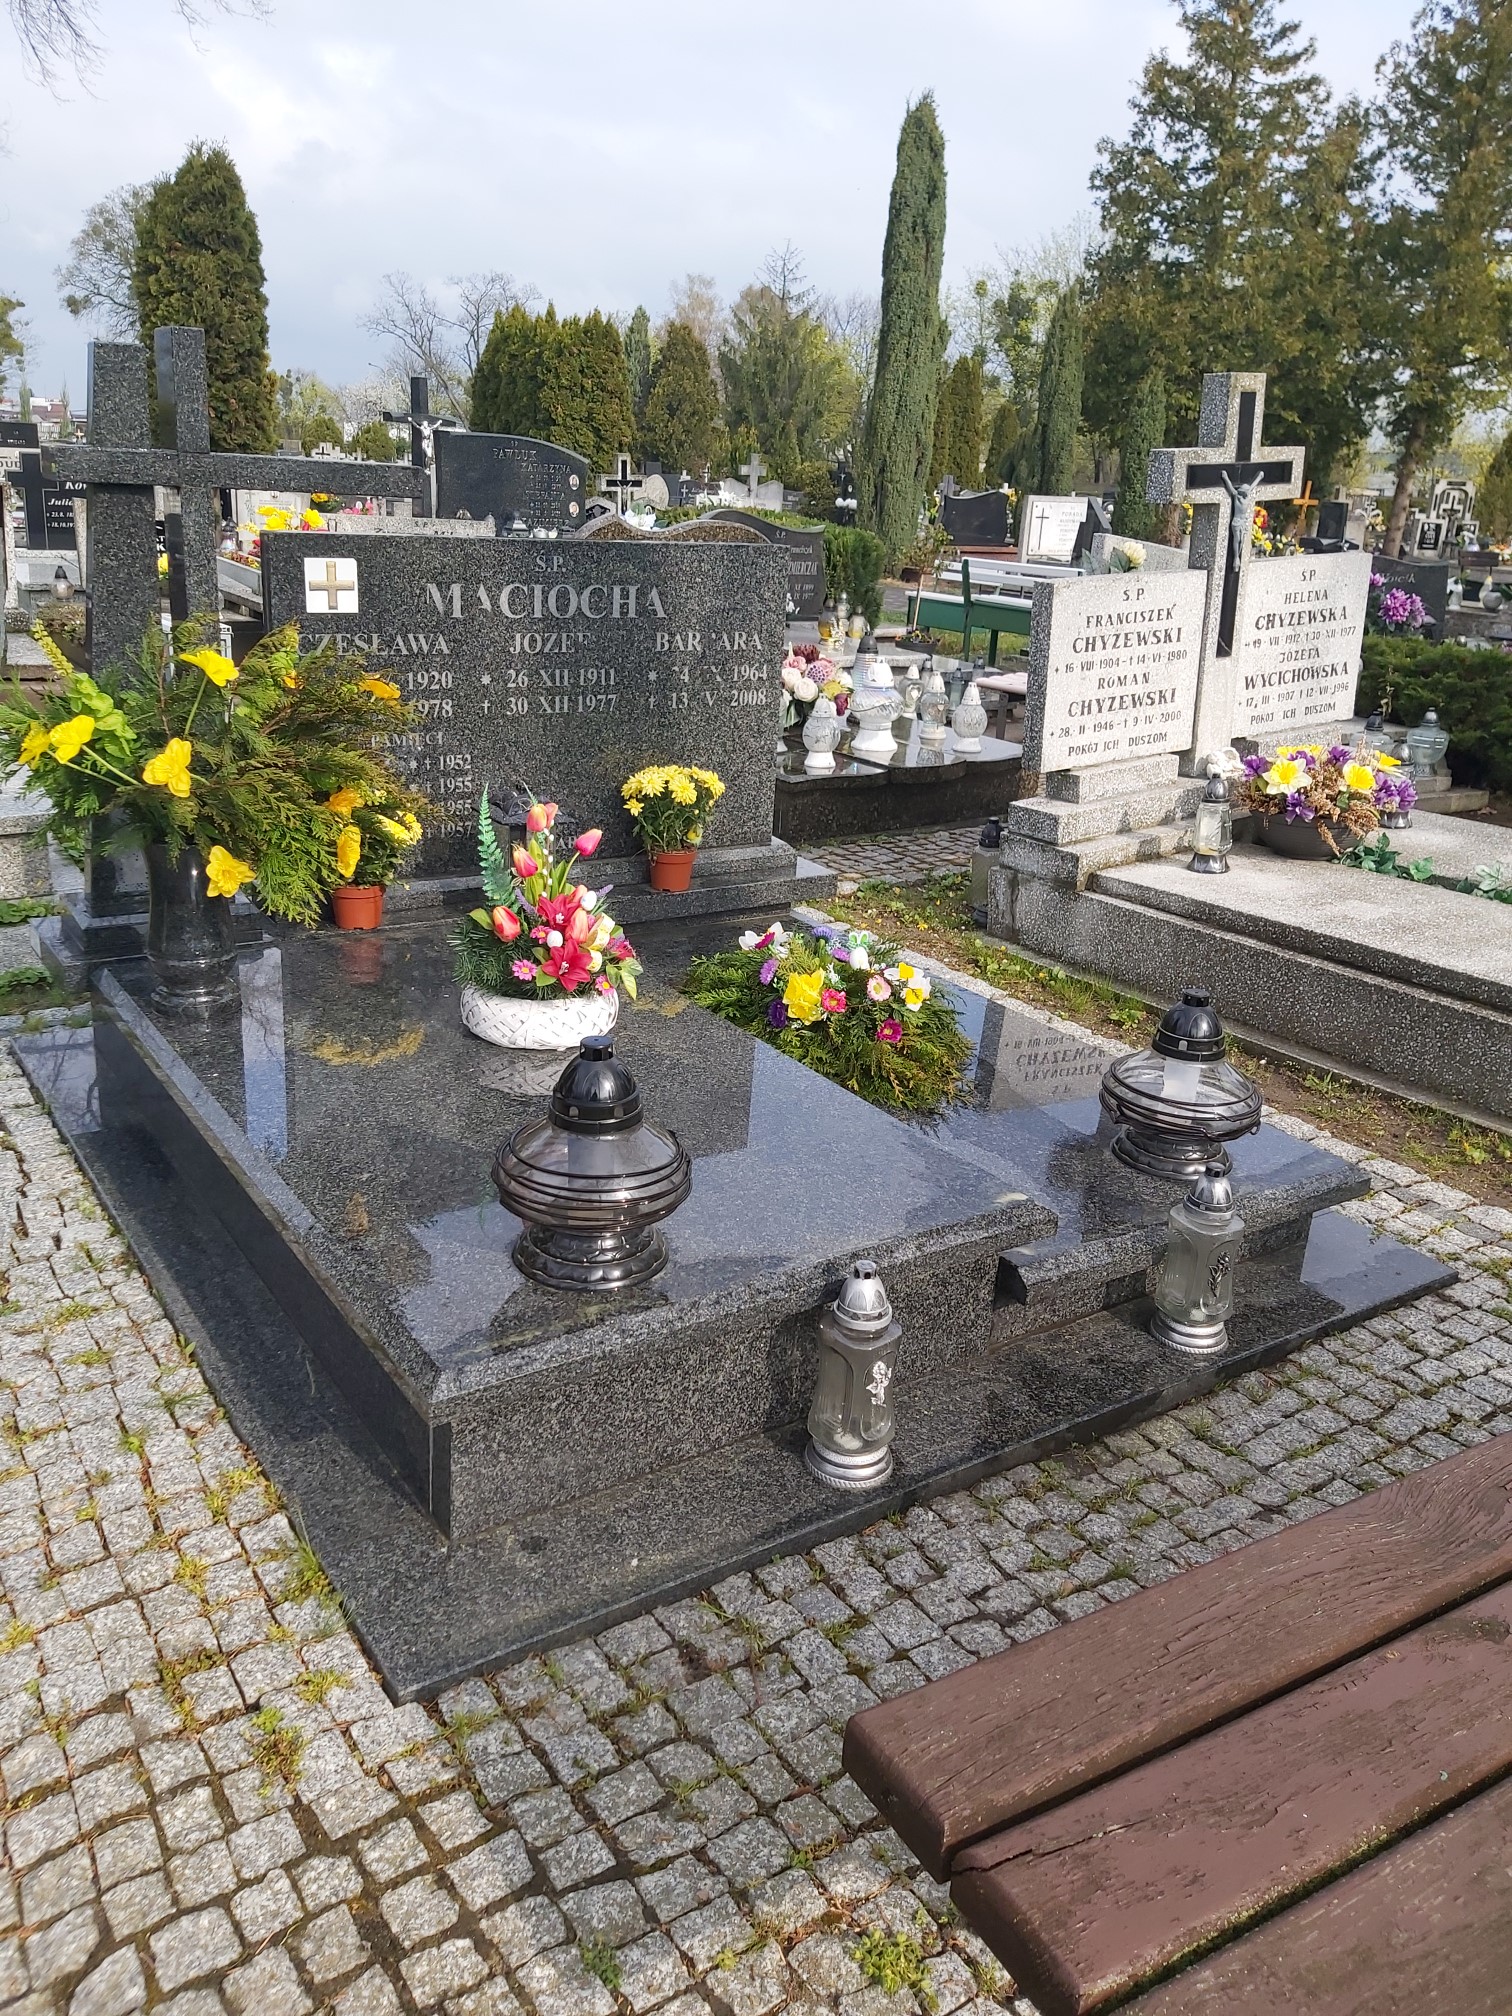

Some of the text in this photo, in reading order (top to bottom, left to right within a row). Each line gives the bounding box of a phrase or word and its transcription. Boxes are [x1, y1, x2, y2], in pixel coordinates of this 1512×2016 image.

[426, 582, 668, 619] MACIOCHA
[1284, 588, 1329, 604] HELENA
[1086, 605, 1176, 628] FRANCISZEK
[655, 631, 762, 651] BARARA
[406, 670, 453, 690] 1920
[506, 667, 616, 689] 26 XII 1911
[732, 663, 768, 681] 1964
[1097, 672, 1151, 690] ROMAN
[1244, 661, 1349, 691] WYCICHOWSKA
[507, 693, 619, 716] 30 XII 1977
[671, 691, 689, 709] 13
[730, 688, 767, 707] 2008
[1128, 731, 1168, 747] DUSZOM
[438, 753, 472, 771] 1952
[439, 777, 473, 794] 1955
